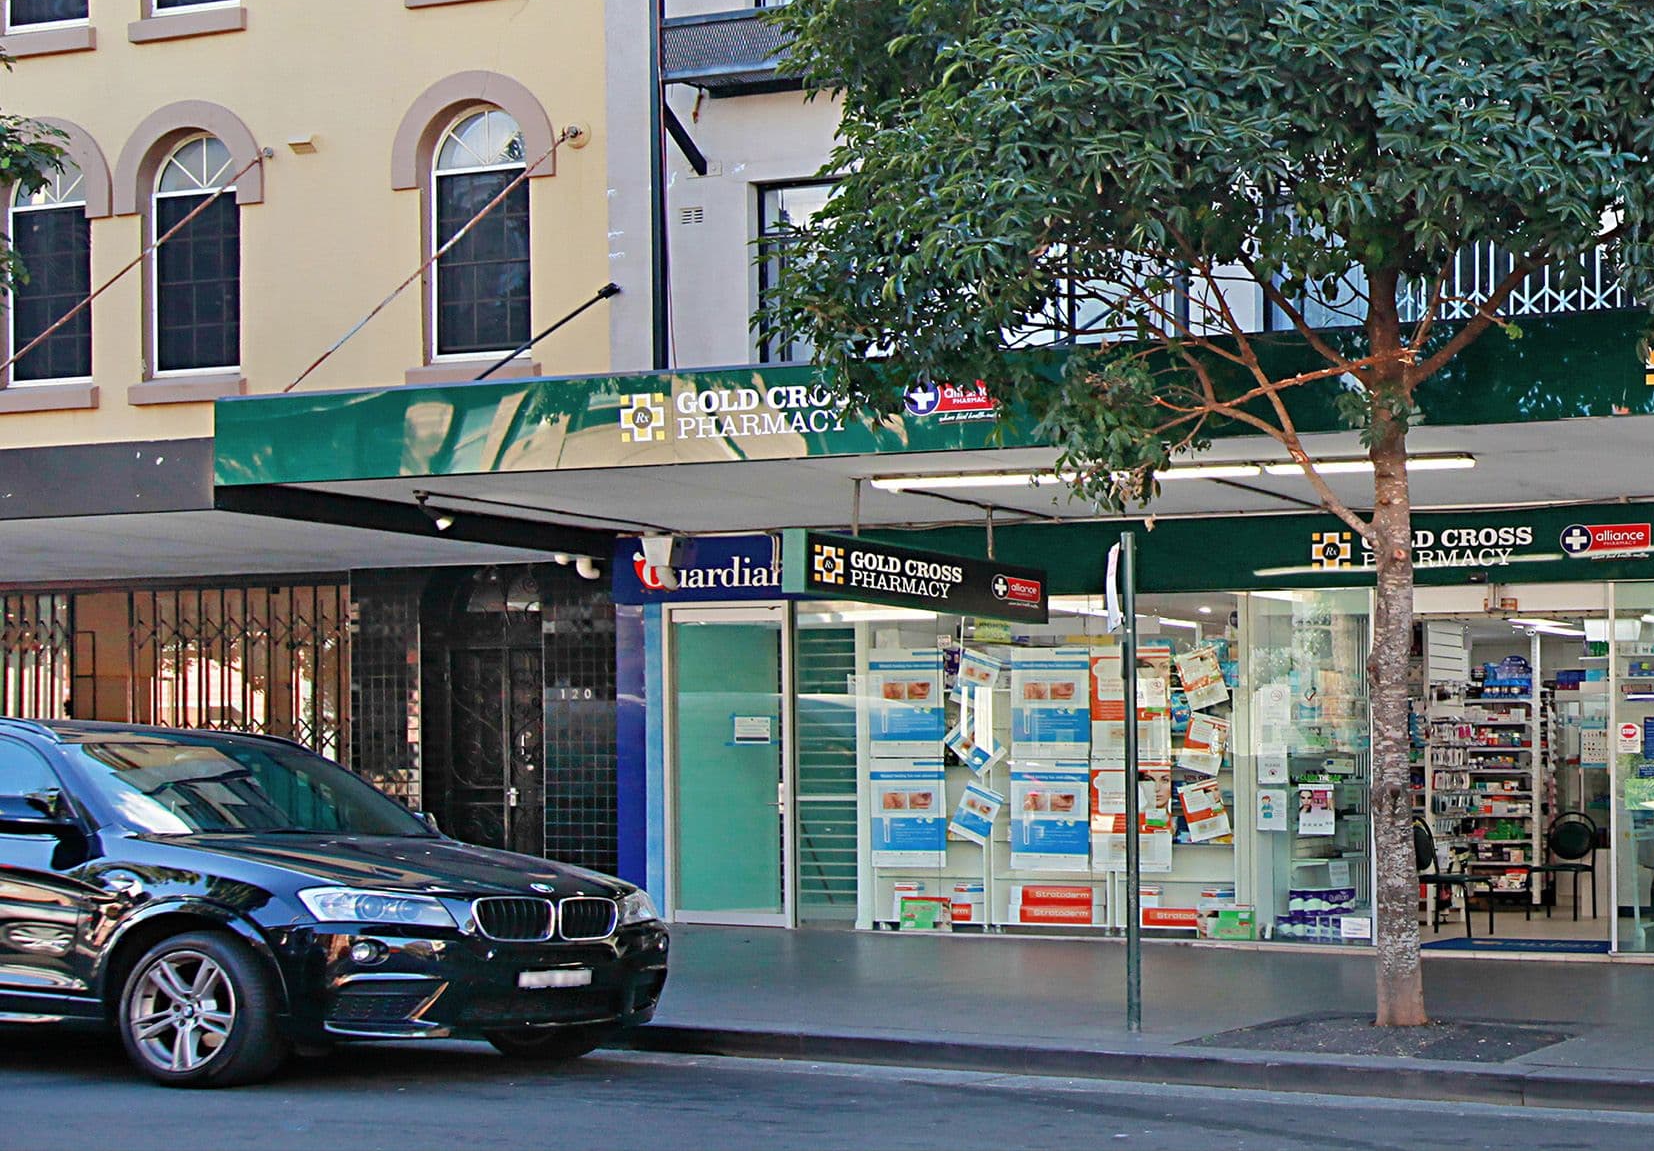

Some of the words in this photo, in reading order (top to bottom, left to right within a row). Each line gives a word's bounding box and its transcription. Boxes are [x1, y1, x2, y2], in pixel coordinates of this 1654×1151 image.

[677, 388, 760, 414] GOLD
[767, 384, 868, 411] CRO
[952, 396, 987, 404] PHARMAC
[677, 409, 846, 439] PHARMACY
[1441, 526, 1533, 548] CROSS
[1595, 529, 1645, 541] alliance
[850, 551, 900, 573] GOLD
[904, 557, 963, 583] CROSS
[1361, 548, 1514, 570] PRMACY
[850, 569, 951, 599] PHARMACY
[560, 688, 592, 700] 120
